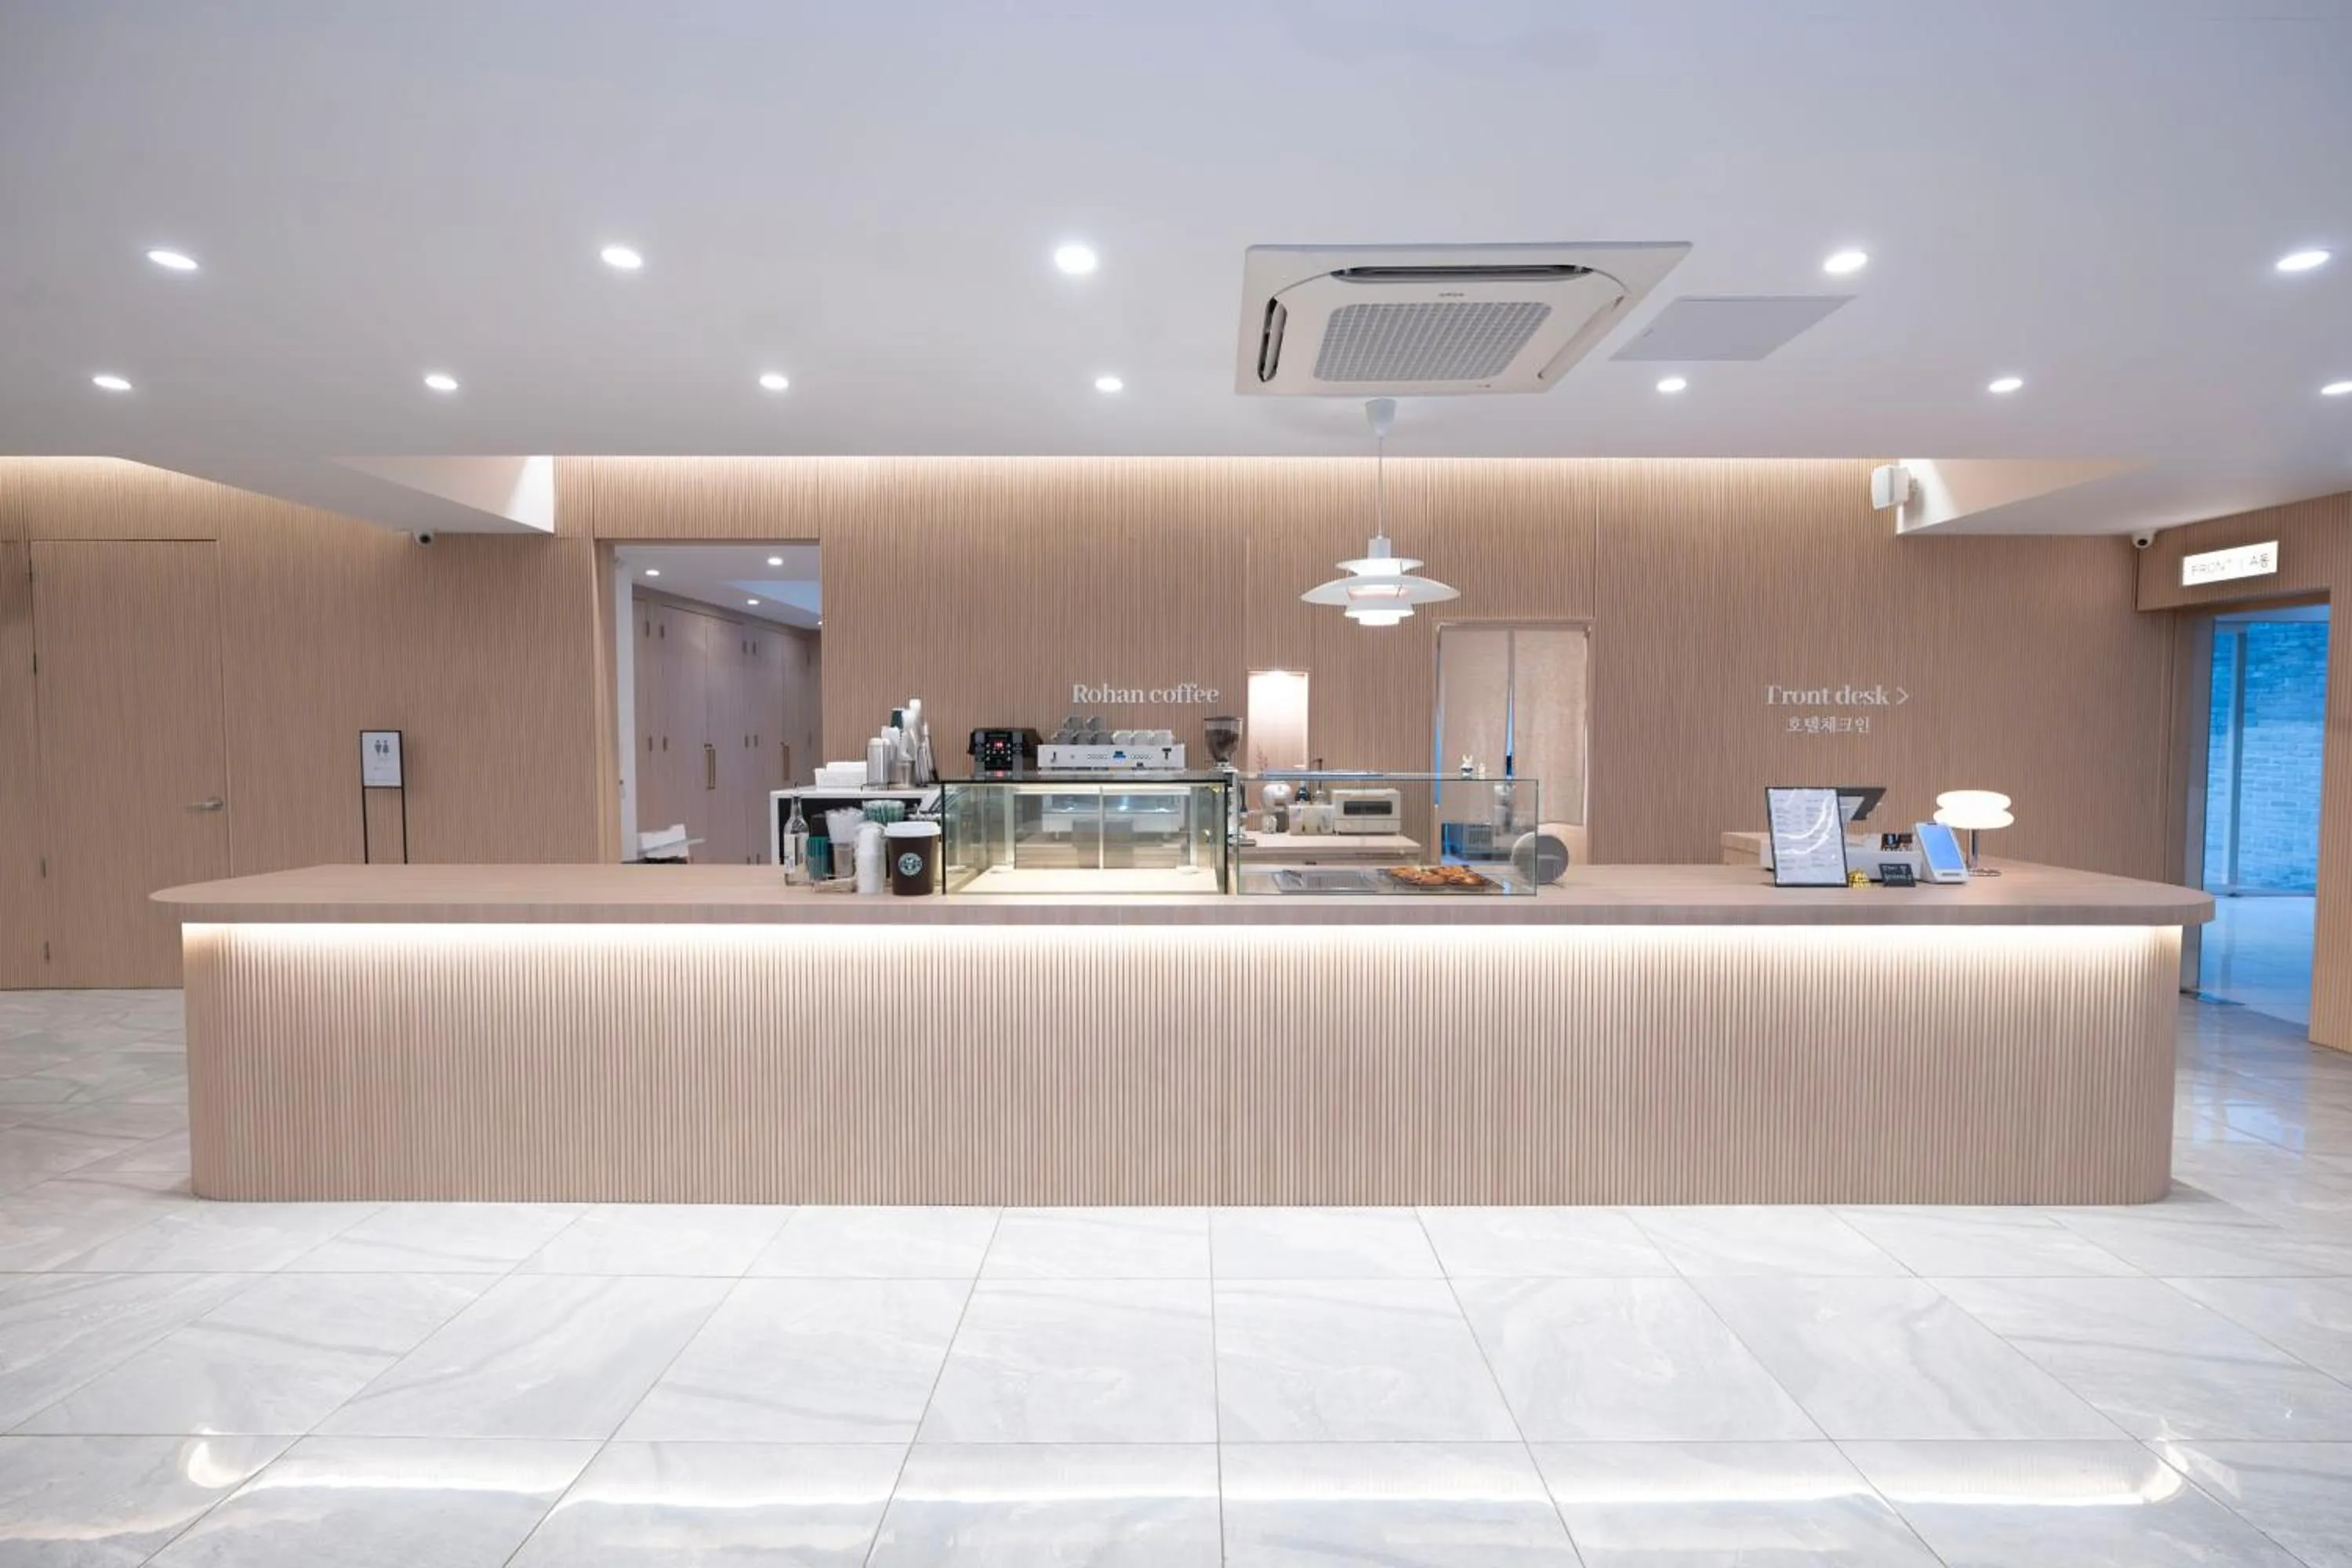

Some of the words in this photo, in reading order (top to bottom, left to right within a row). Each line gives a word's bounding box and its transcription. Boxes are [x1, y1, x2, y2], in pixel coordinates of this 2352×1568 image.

[1073, 683, 1145, 703] Rohan
[1149, 682, 1220, 703] coffee
[1766, 684, 1831, 705] Front
[1835, 684, 1890, 706] desk
[1786, 716, 1870, 735] 호텔체크인
